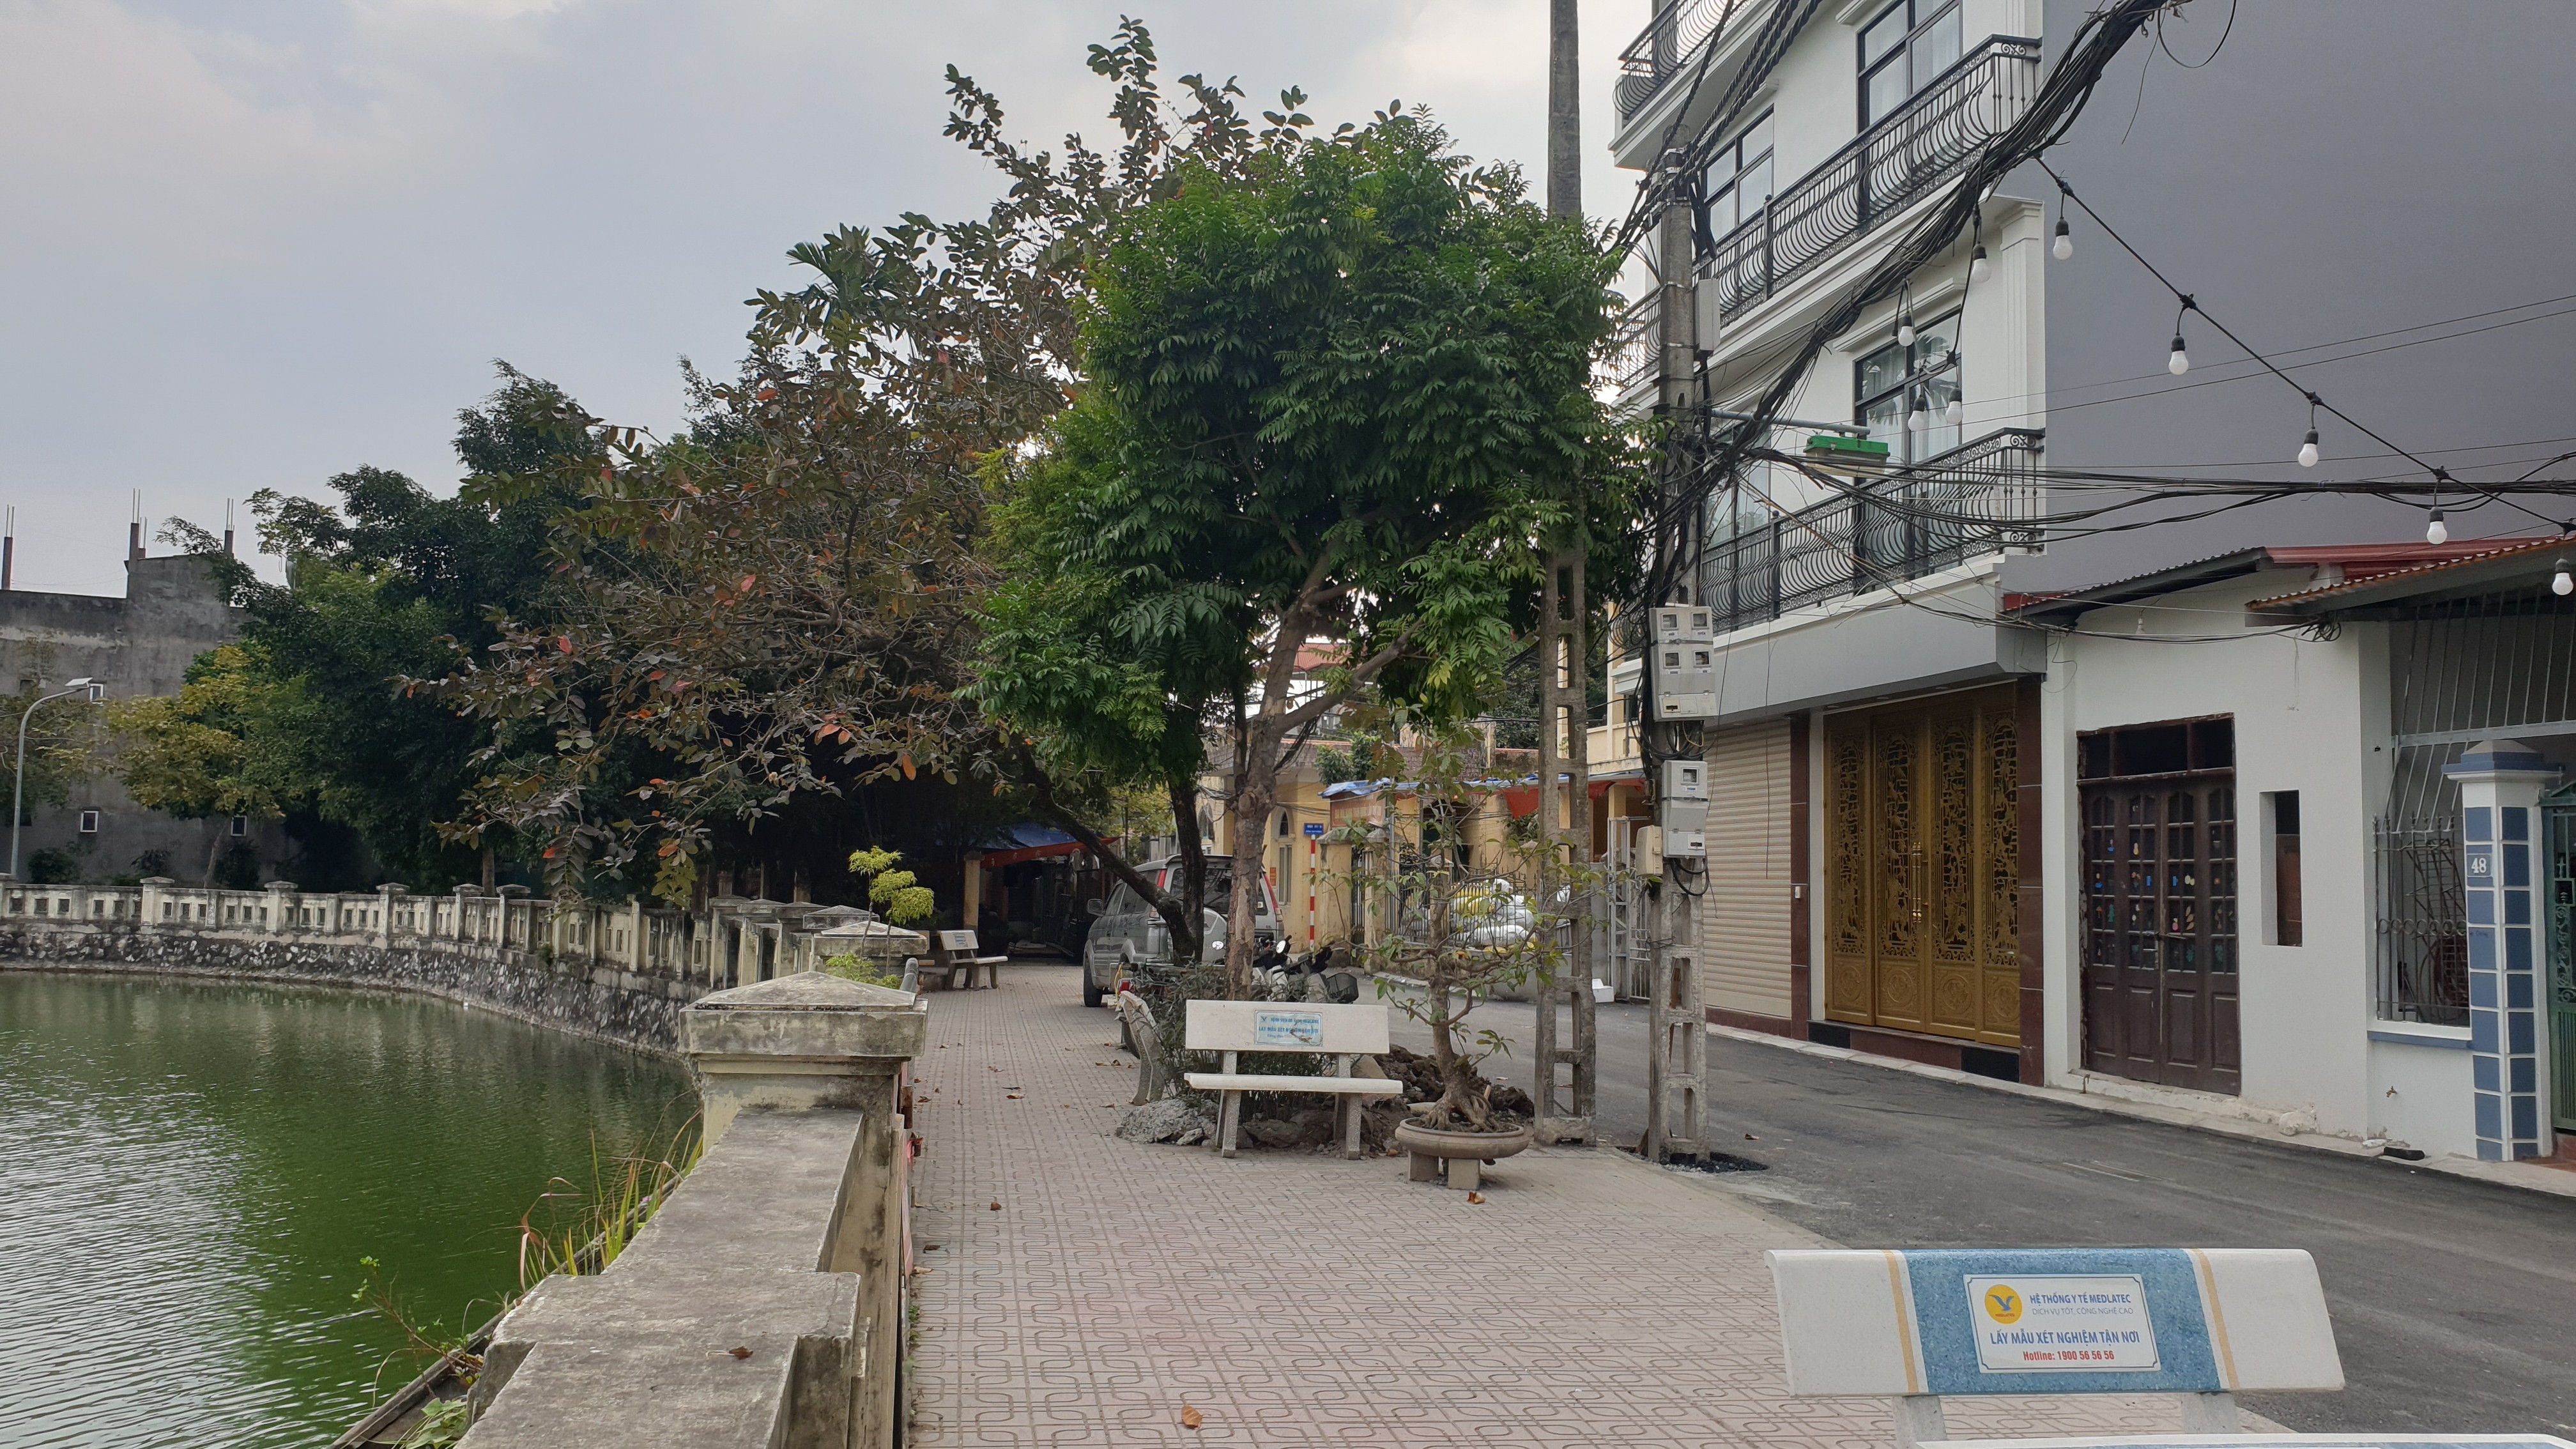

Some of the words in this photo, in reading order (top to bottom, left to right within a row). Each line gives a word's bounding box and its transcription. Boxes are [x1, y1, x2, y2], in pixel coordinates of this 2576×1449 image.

[2471, 857, 2487, 873] 48
[2029, 1292, 2041, 1307] HỆ
[2043, 1291, 2071, 1304] THỐNG
[2071, 1294, 2077, 1303] Y
[2078, 1291, 2089, 1303] TẾ
[2090, 1294, 2131, 1303] MEDLATEC
[2076, 1307, 2097, 1315] CÔNG
[1990, 1329, 2008, 1344] LẤY
[2011, 1328, 2035, 1344] MẪU
[2036, 1330, 2054, 1344] XÉT
[2057, 1329, 2099, 1346] NGHIỆM
[2099, 1329, 2120, 1346] TẬN
[2121, 1330, 2140, 1344] NƠI
[2023, 1351, 2056, 1361] Hotline:
[2057, 1351, 2078, 1360] 1900
[2079, 1350, 2090, 1360] 56
[2091, 1350, 2103, 1360] 56
[2103, 1350, 2115, 1360] 56
